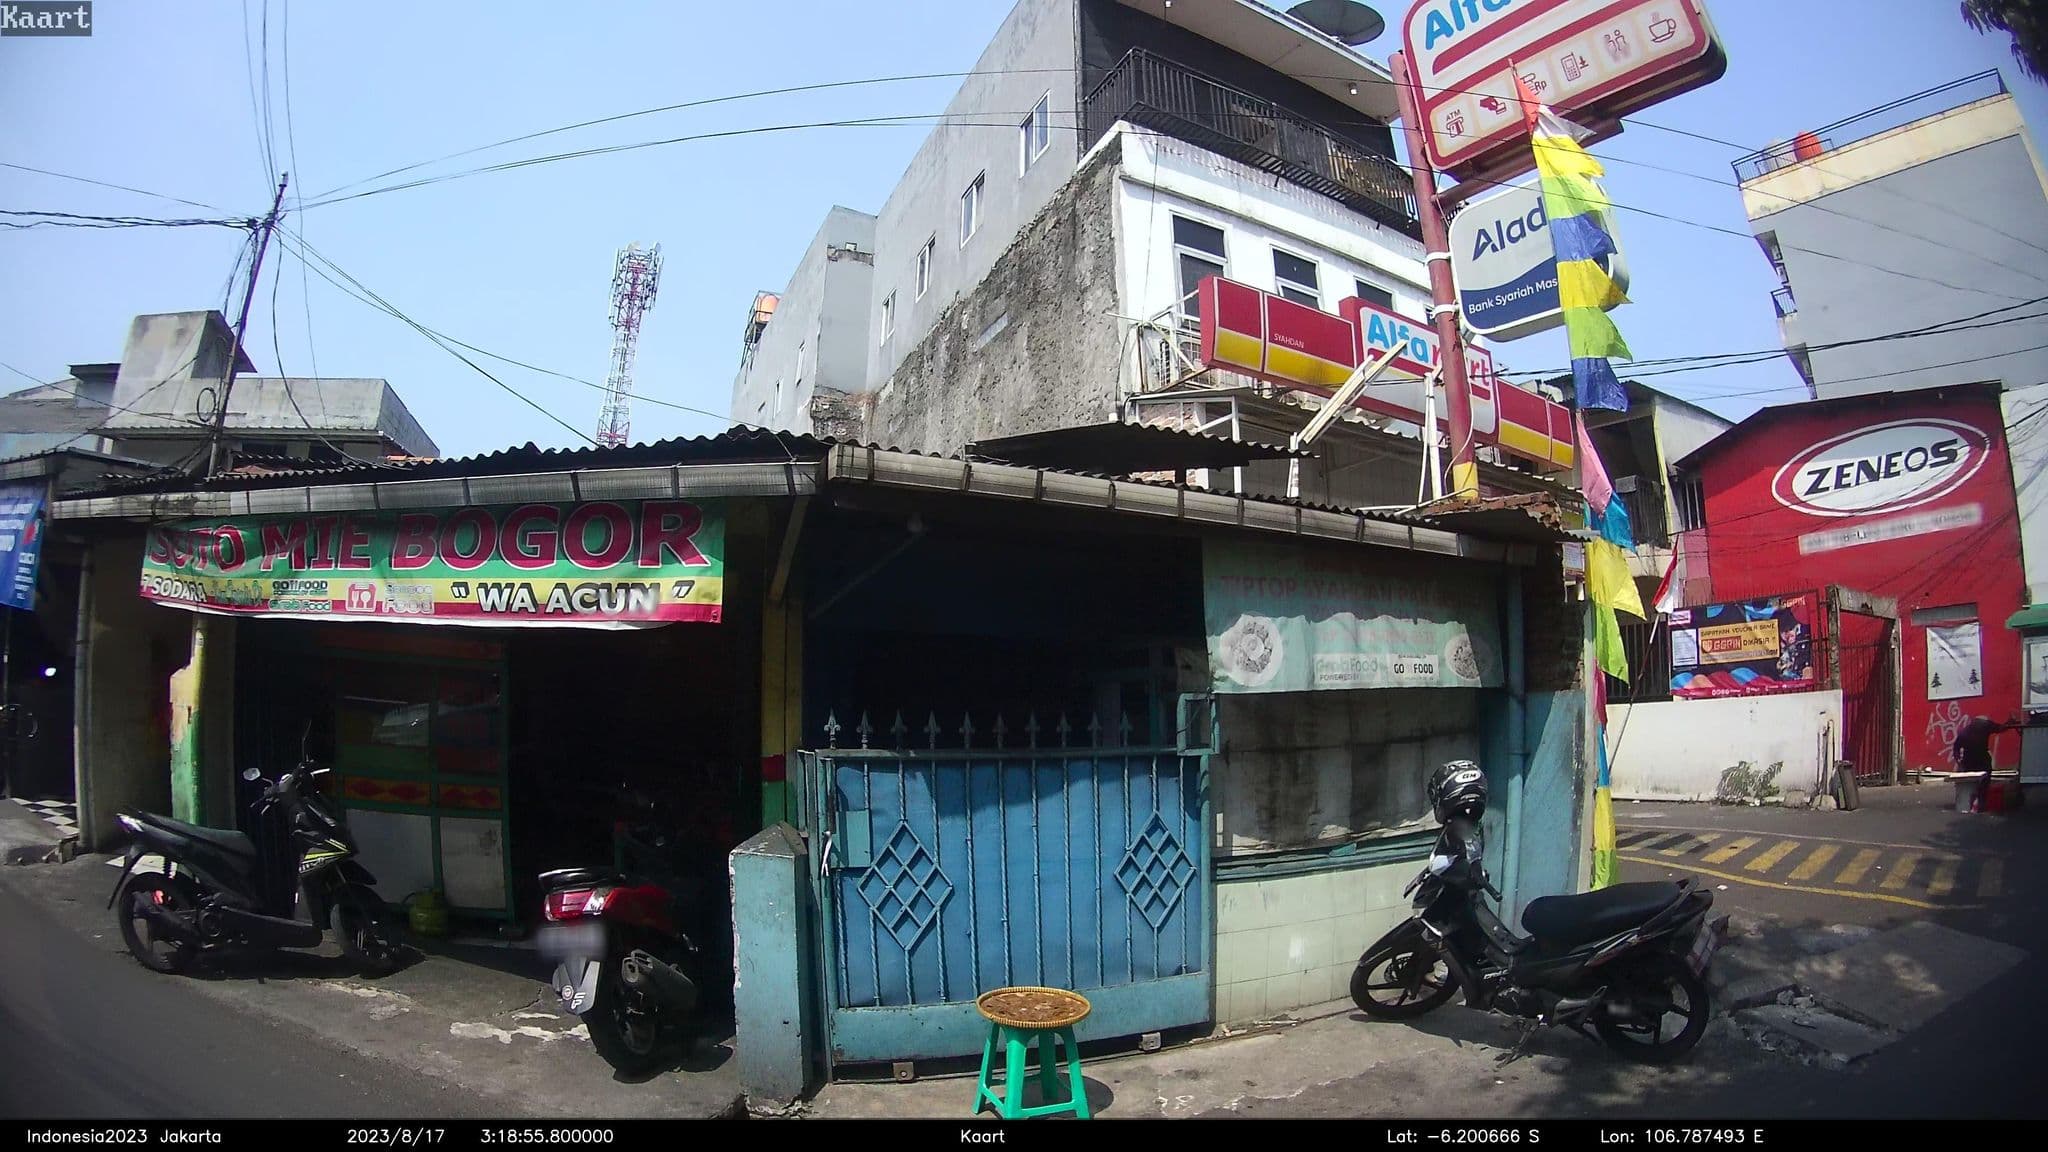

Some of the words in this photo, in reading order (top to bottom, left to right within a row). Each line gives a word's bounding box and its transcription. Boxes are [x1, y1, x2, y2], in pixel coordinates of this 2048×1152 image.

[1446, 109, 1461, 121] ATM
[1472, 196, 1547, 262] Alad
[1469, 298, 1494, 314] Bank
[1495, 284, 1535, 306] Syariah
[1536, 277, 1558, 292] Mas
[1273, 333, 1305, 349] SYAHDAN
[1803, 438, 1958, 497] ZENEOS
[150, 524, 247, 573] SOTO
[260, 516, 372, 572] MIE
[391, 500, 711, 571] BOGOR
[152, 576, 208, 602] SODARA
[1393, 663, 1405, 674] GO
[1413, 663, 1434, 674] FOOD
